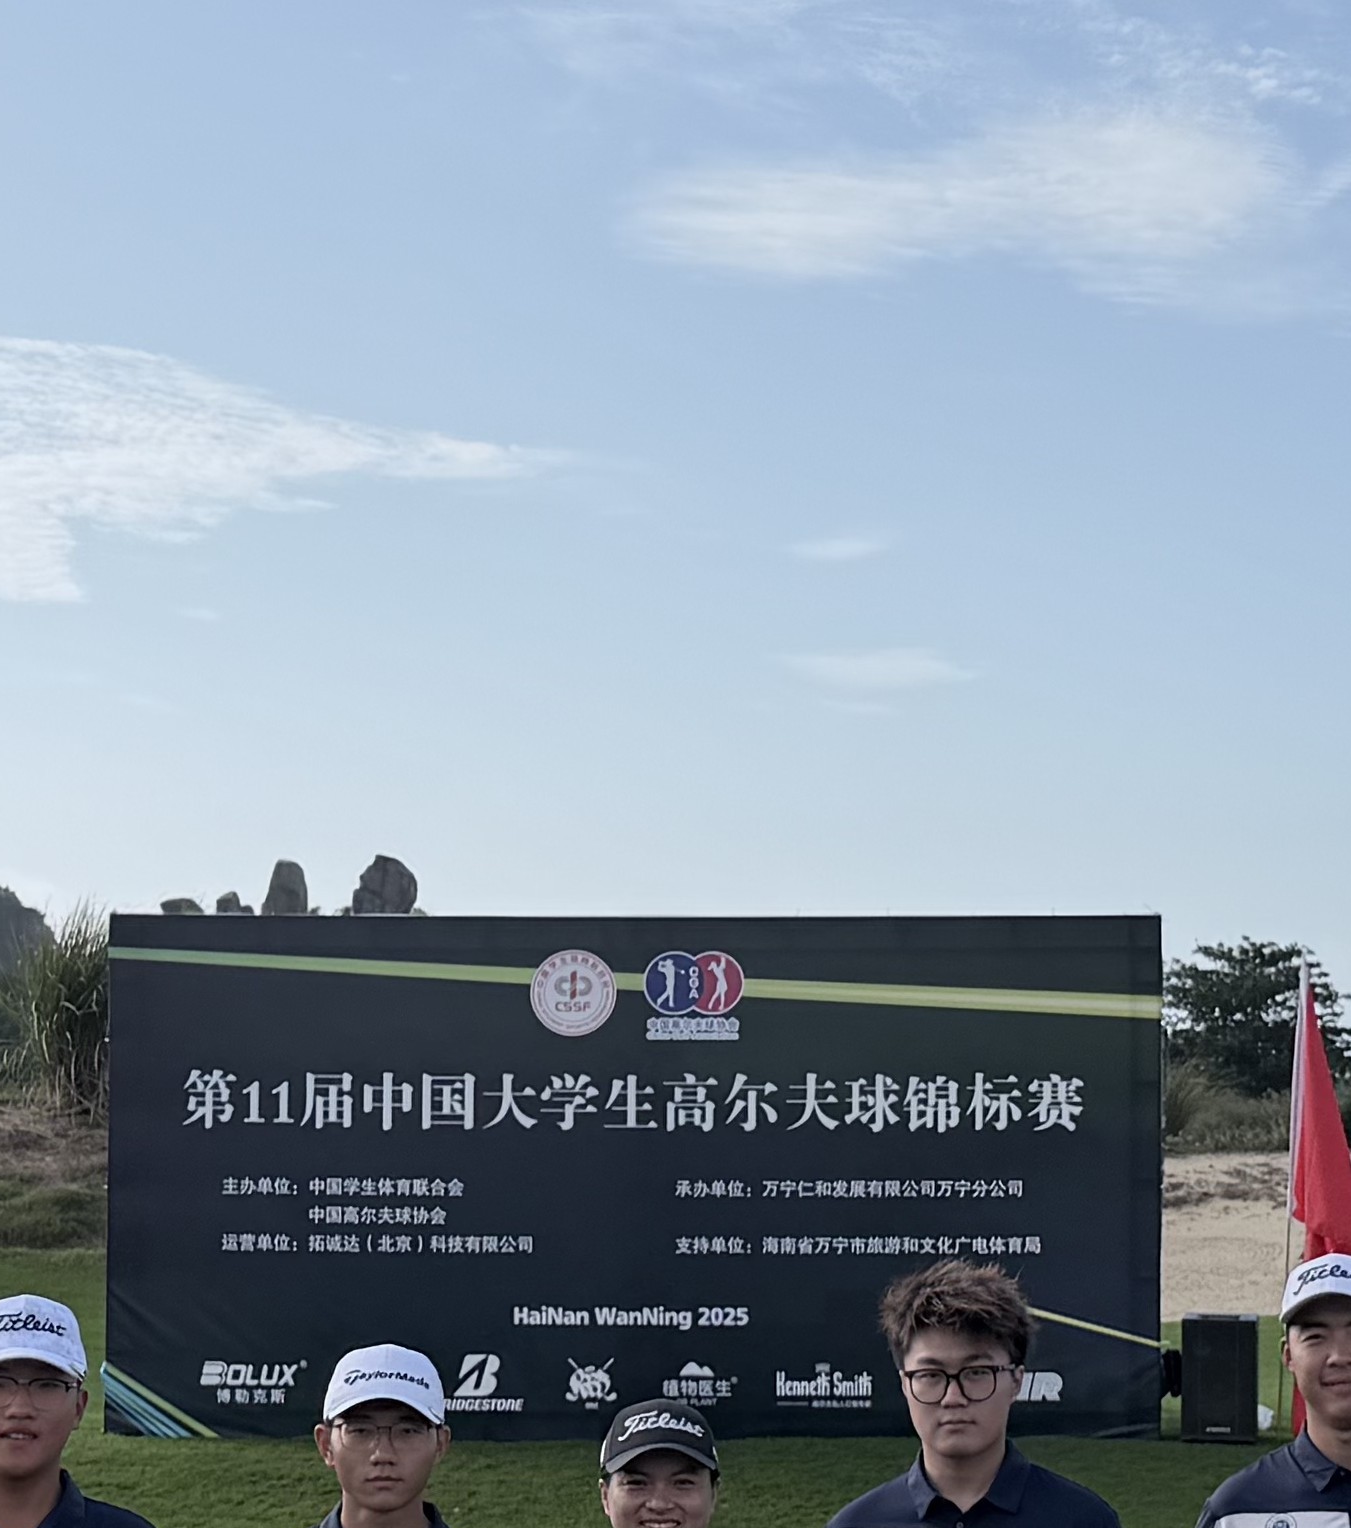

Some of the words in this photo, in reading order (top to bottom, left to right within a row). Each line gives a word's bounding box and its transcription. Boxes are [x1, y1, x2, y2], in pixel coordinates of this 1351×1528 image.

[555, 1001, 592, 1013] CSSF
[183, 1069, 1085, 1133] 第11届中国大学生高尔夫球锦标赛
[308, 1205, 448, 1225] 中国高尔夫球协会
[513, 1305, 590, 1326] HaiNan
[594, 1305, 692, 1331] WanNing
[697, 1307, 750, 1326] 2025
[200, 1360, 298, 1387] BOLUX
[344, 1370, 430, 1389] TaylorMade
[776, 1371, 831, 1397] Kenneth
[832, 1371, 873, 1397] Smith
[443, 1398, 525, 1412] RIDGESTONE
[618, 1410, 705, 1442] Titleist
